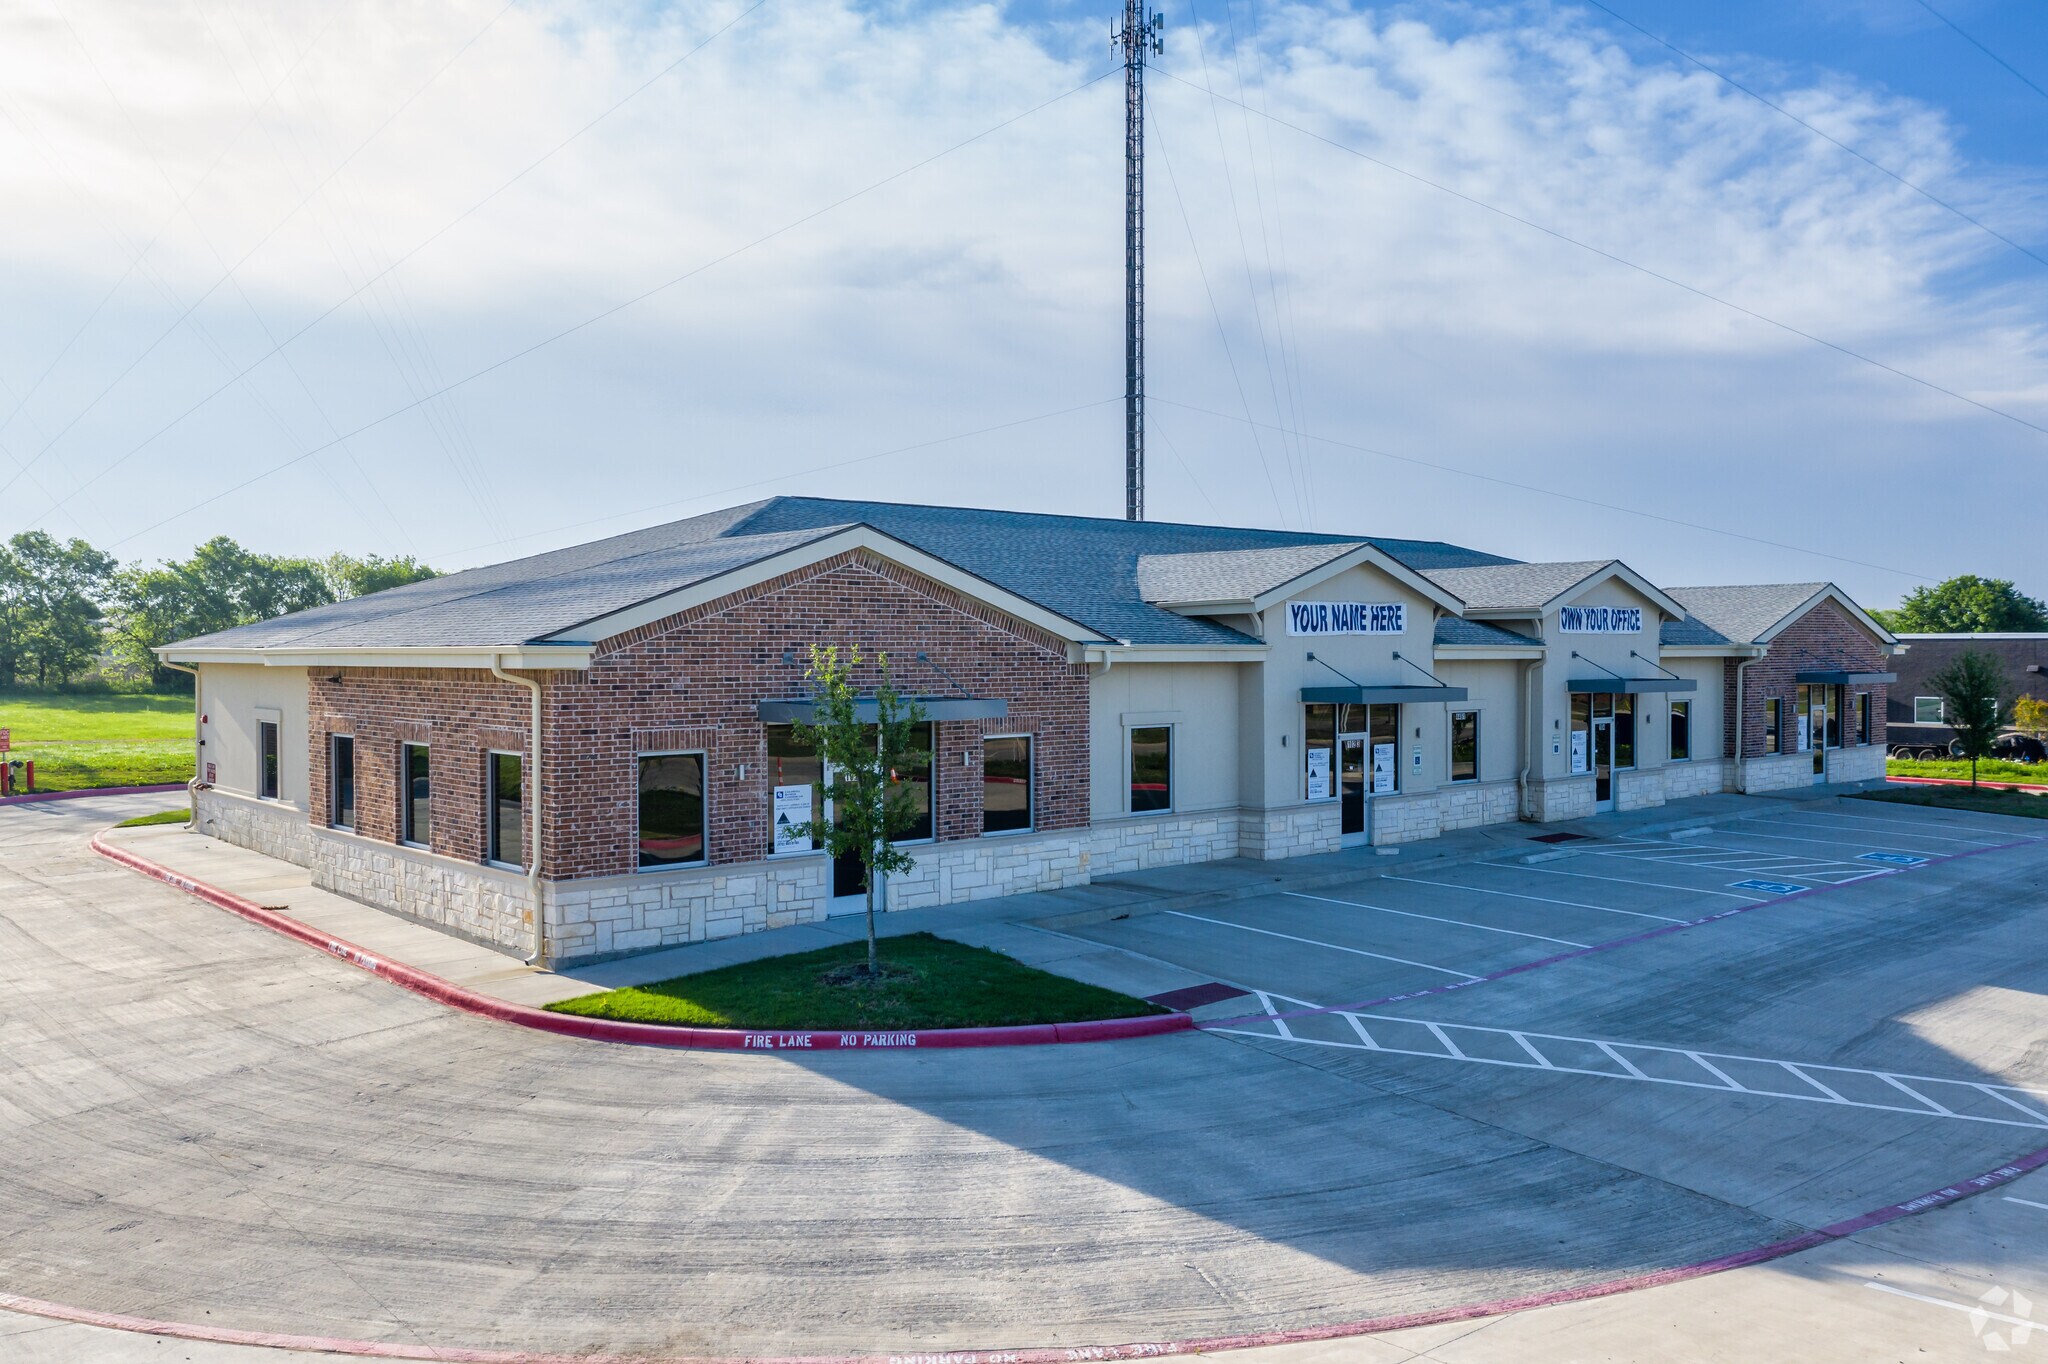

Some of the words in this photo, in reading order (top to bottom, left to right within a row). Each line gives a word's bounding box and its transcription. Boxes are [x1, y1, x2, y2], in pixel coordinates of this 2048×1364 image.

[1291, 604, 1328, 632] YOUR
[1331, 604, 1367, 631] NAME
[1370, 605, 1402, 631] HERE
[1561, 607, 1582, 630] OWN
[1584, 608, 1608, 630] YOUR
[1611, 609, 1640, 631] OFFICE
[744, 1035, 773, 1048] FIRE
[779, 1035, 812, 1047] LANE
[840, 1034, 857, 1046] NO
[863, 1034, 916, 1046] PARKING
[1993, 1166, 2022, 1176] FIRE
[1969, 1174, 2001, 1186] LANE
[1897, 1193, 1945, 1211] PARKING
[1065, 1347, 1120, 1360] LANE
[1132, 1342, 1177, 1355] FIRE
[889, 1354, 977, 1364] PARKING
[989, 1354, 1017, 1363] NO
